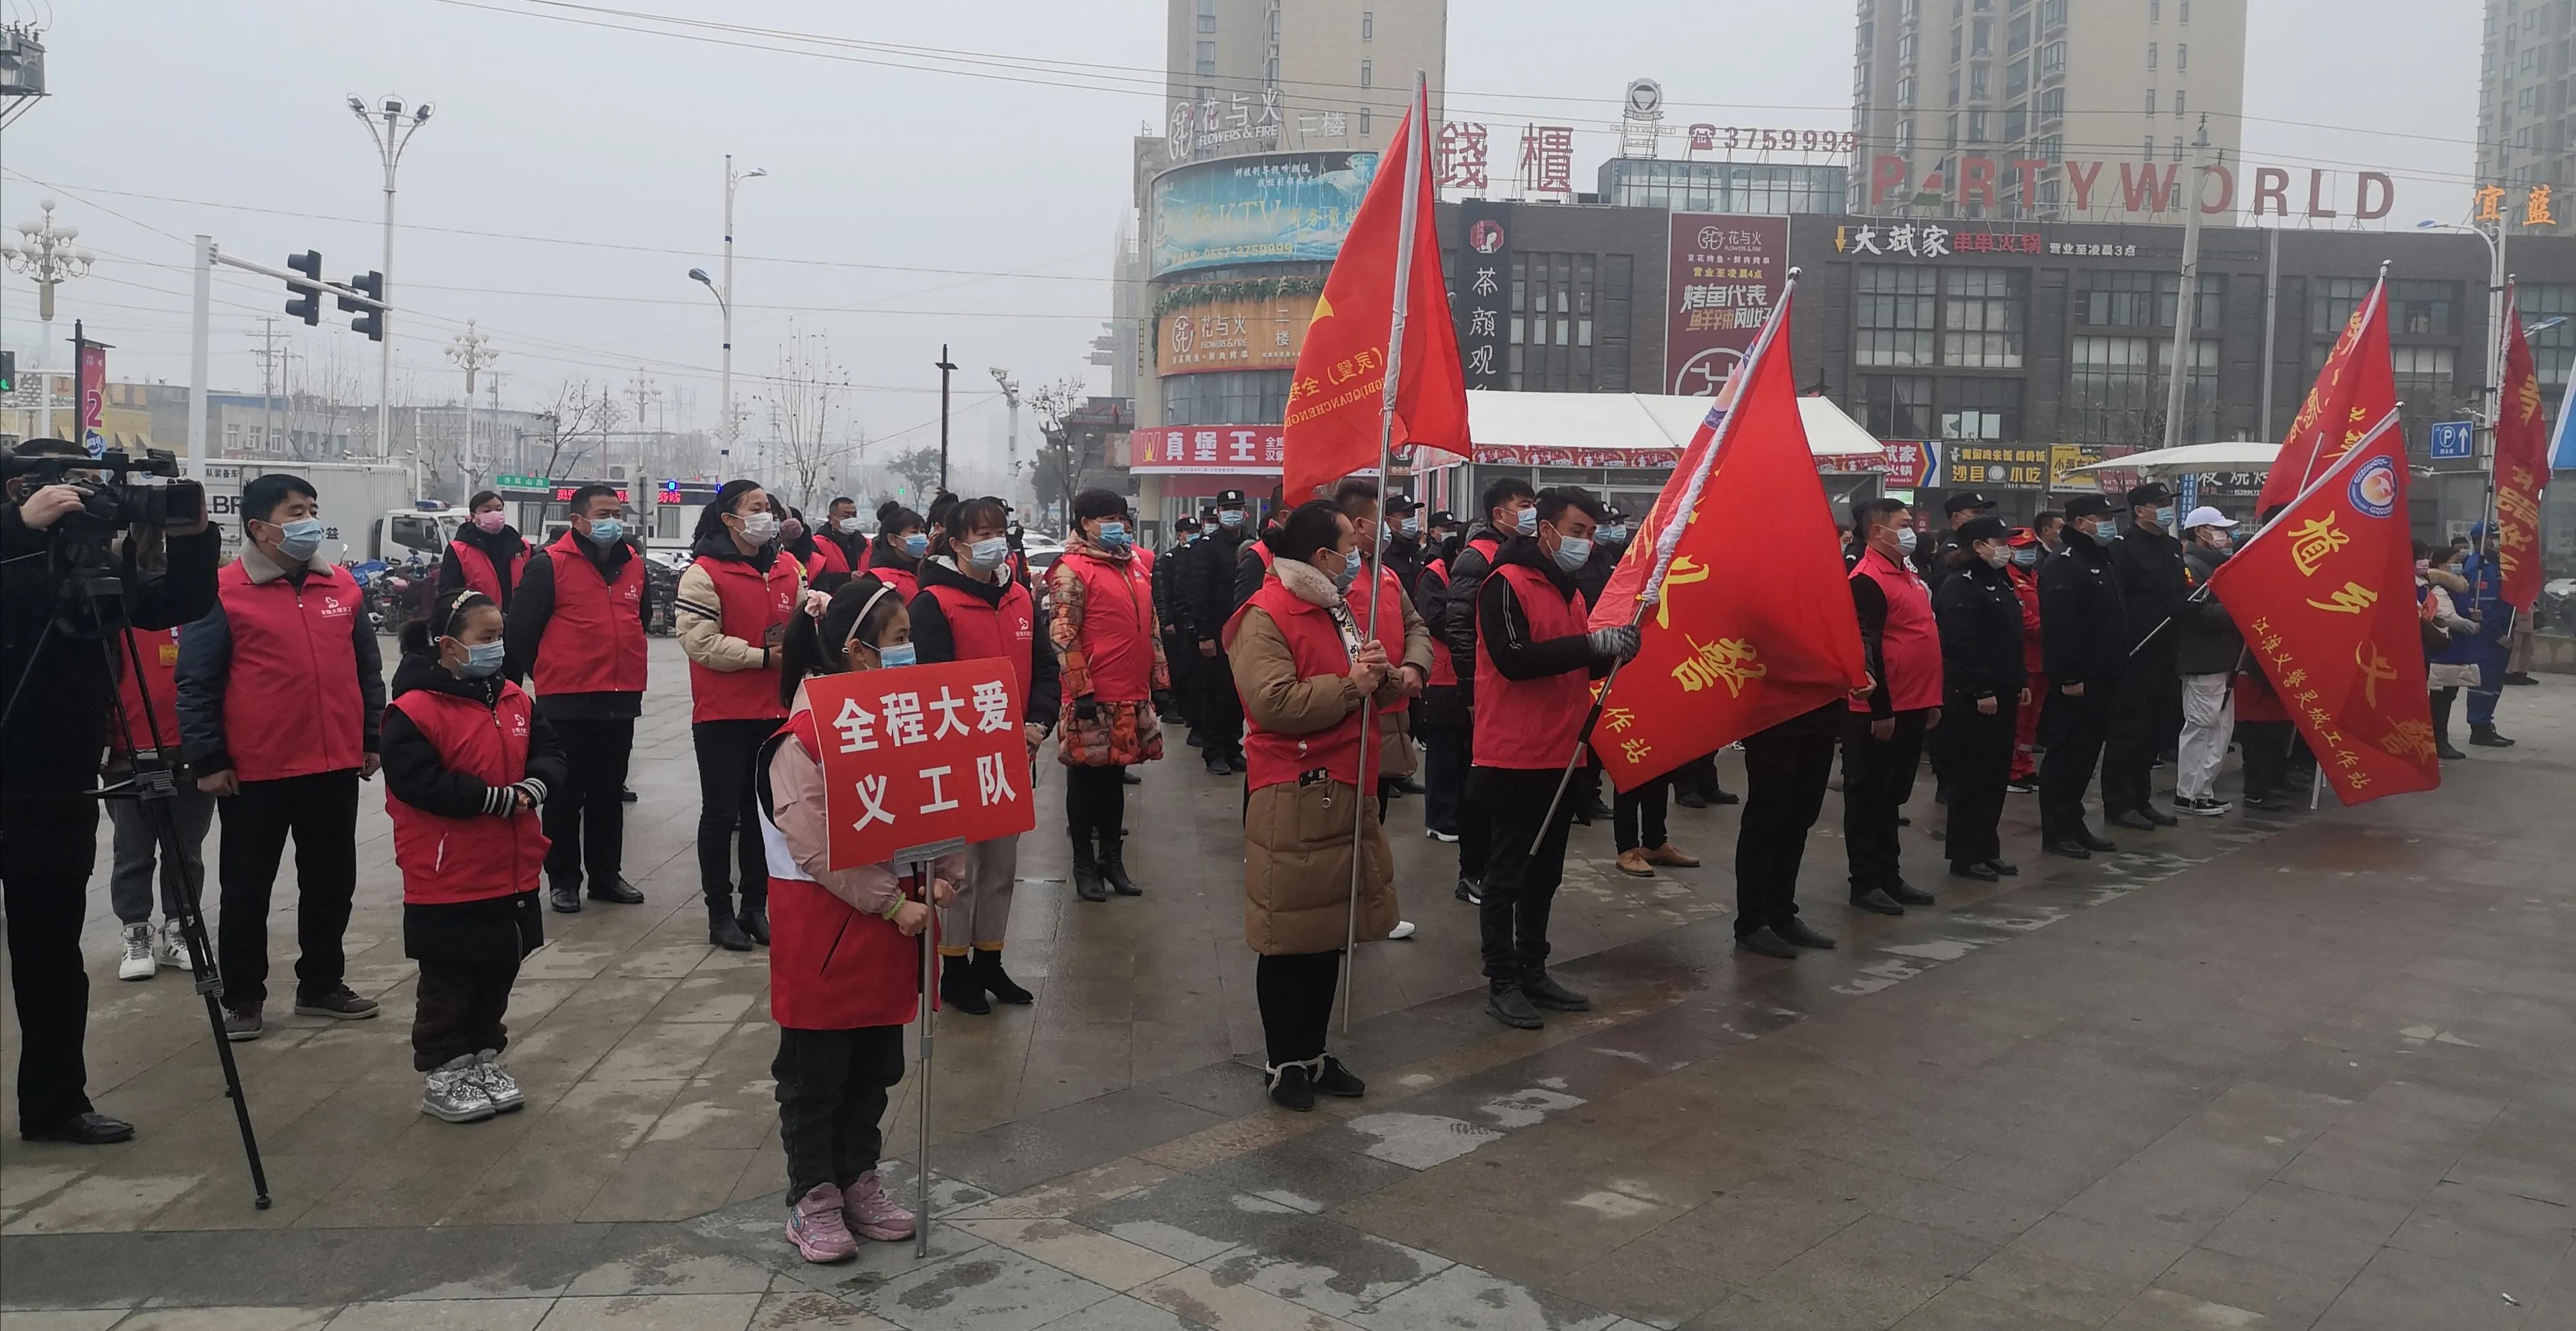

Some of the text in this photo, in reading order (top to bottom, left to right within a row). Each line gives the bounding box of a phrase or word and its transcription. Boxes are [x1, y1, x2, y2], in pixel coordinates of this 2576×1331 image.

[1203, 88, 1282, 132] 花与火
[1298, 112, 1346, 137] 二楼
[1198, 125, 1278, 146] FLOWERS & FIRE
[1724, 126, 1857, 152] 3759999
[2475, 184, 2557, 226] 宜蓝
[1728, 231, 1761, 244] 花与火
[1852, 224, 2137, 257] 大斌家 串串火锅 营业至凌晨3点
[1694, 267, 1762, 279] 营业至凌晨4点
[1680, 283, 1767, 314] 烤鱼代表
[1202, 313, 1247, 338] 花与火
[1166, 431, 1256, 461] 真堡王
[1952, 464, 2041, 483] 沙县 小吃
[833, 680, 1012, 754] 全程大爱
[2252, 616, 2371, 789] 江淮义警灵城工作站
[853, 752, 1016, 832] 义工队
